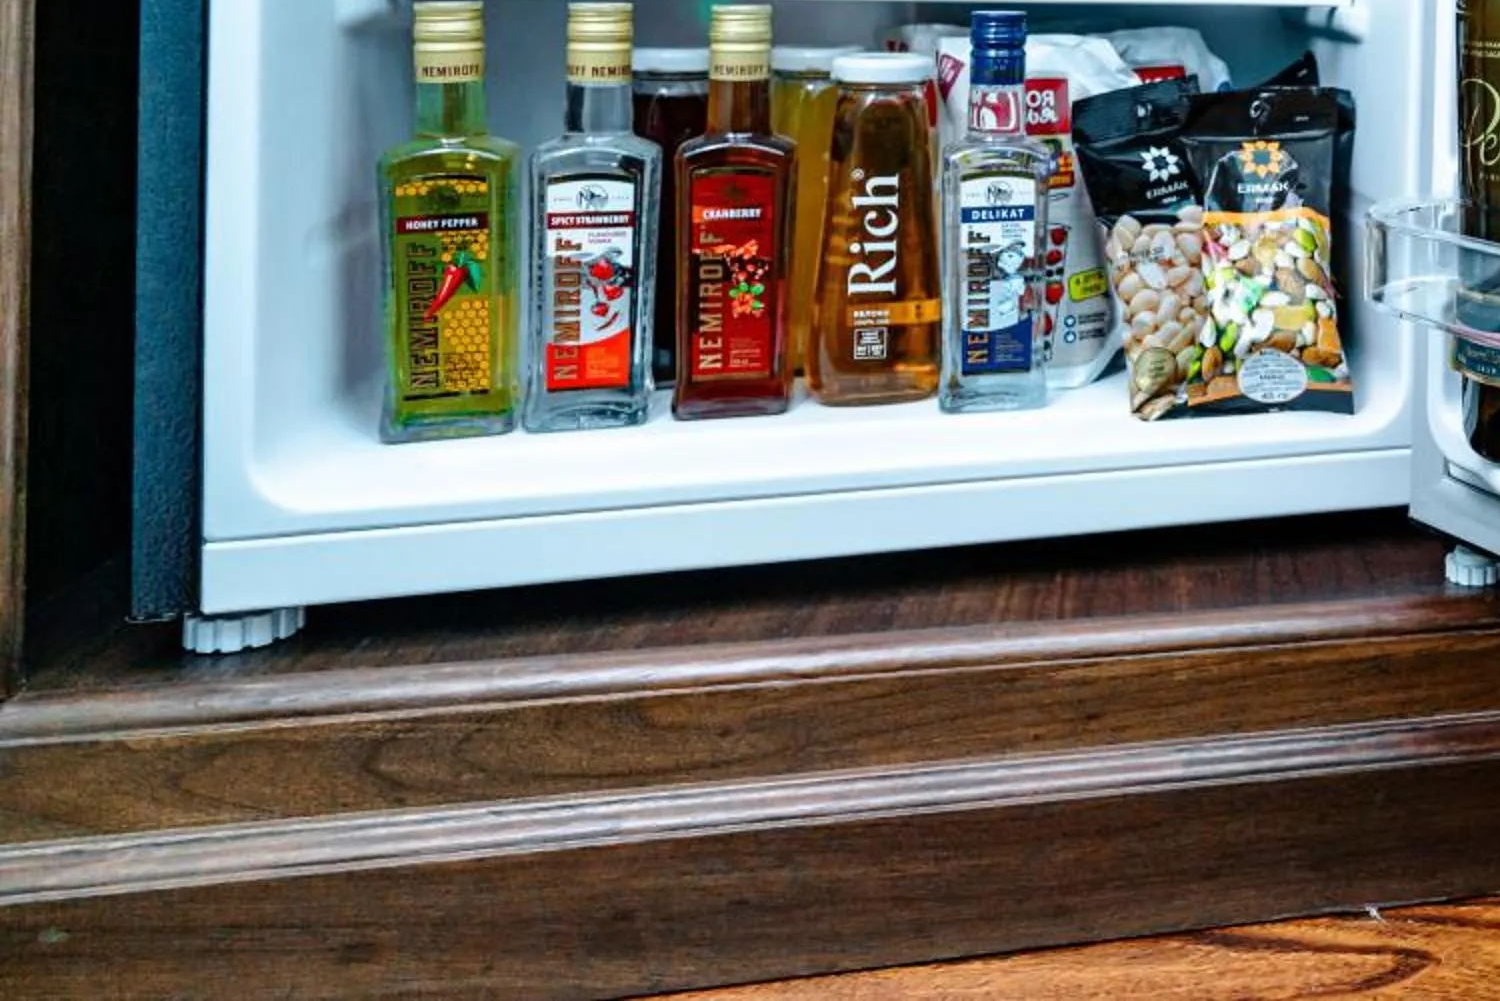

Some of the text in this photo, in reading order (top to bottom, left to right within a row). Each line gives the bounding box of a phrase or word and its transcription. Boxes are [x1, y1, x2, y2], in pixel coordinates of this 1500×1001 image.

[421, 64, 480, 78] NEMIROFF
[405, 216, 478, 231] HONEY PEPPER
[551, 214, 629, 227] SPICY STRAWBERRY
[703, 208, 761, 220] CRANBERRY
[848, 173, 899, 296] Rich
[971, 208, 1024, 221] DELIKAT
[408, 242, 439, 390] NEMIROFF
[554, 237, 582, 380] NEMIROFF
[699, 230, 724, 369] NEMIROFF
[968, 230, 991, 365] NEMIROFF
